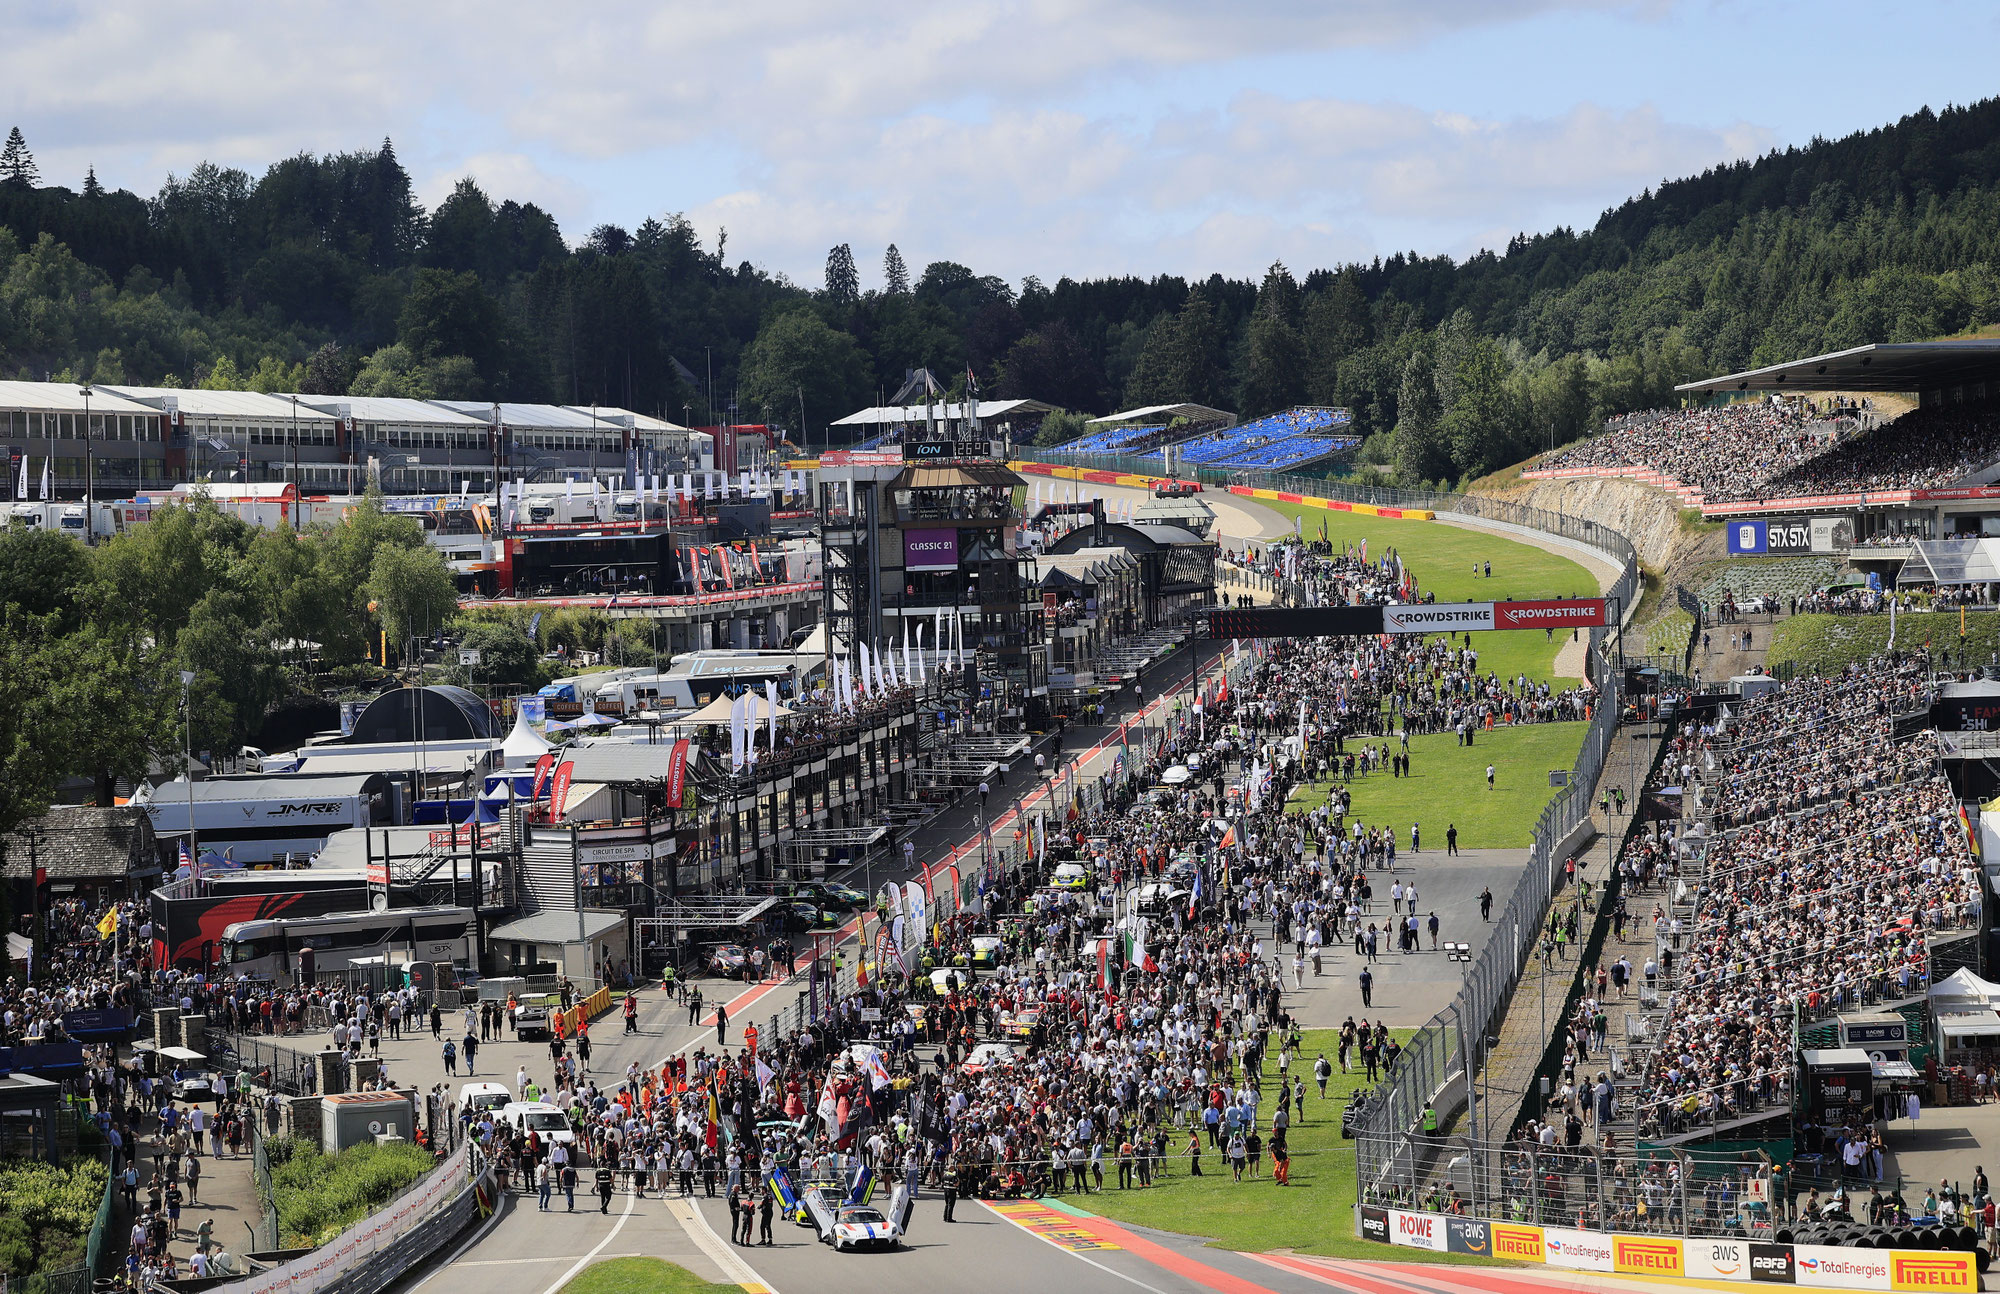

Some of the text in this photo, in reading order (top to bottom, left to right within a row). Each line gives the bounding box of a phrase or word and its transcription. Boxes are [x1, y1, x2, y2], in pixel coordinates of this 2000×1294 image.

[172, 412, 177, 423] 4
[346, 418, 351, 428] 5
[1769, 527, 1809, 547] STX STX
[910, 542, 942, 550] CLASSIC
[1397, 610, 1490, 623] CROWDSTRIKE
[1510, 607, 1596, 619] CROWDSTRIKE
[671, 752, 682, 798] CROWDSTRIKE
[1829, 1077, 1847, 1085] FAN
[1825, 1086, 1846, 1096] SHOP
[1826, 1108, 1842, 1117] OFF
[1400, 1215, 1432, 1238] ROWE
[1460, 1230, 1464, 1238] by
[1465, 1223, 1484, 1239] aws
[1496, 1230, 1540, 1256] PIRELLI
[1562, 1243, 1610, 1261] TotalEnergies
[1618, 1243, 1677, 1269] PIRELLI
[1712, 1245, 1739, 1261] aws
[1820, 1260, 1886, 1278] TotalEnergies
[1896, 1259, 1967, 1285] PIRELLI
